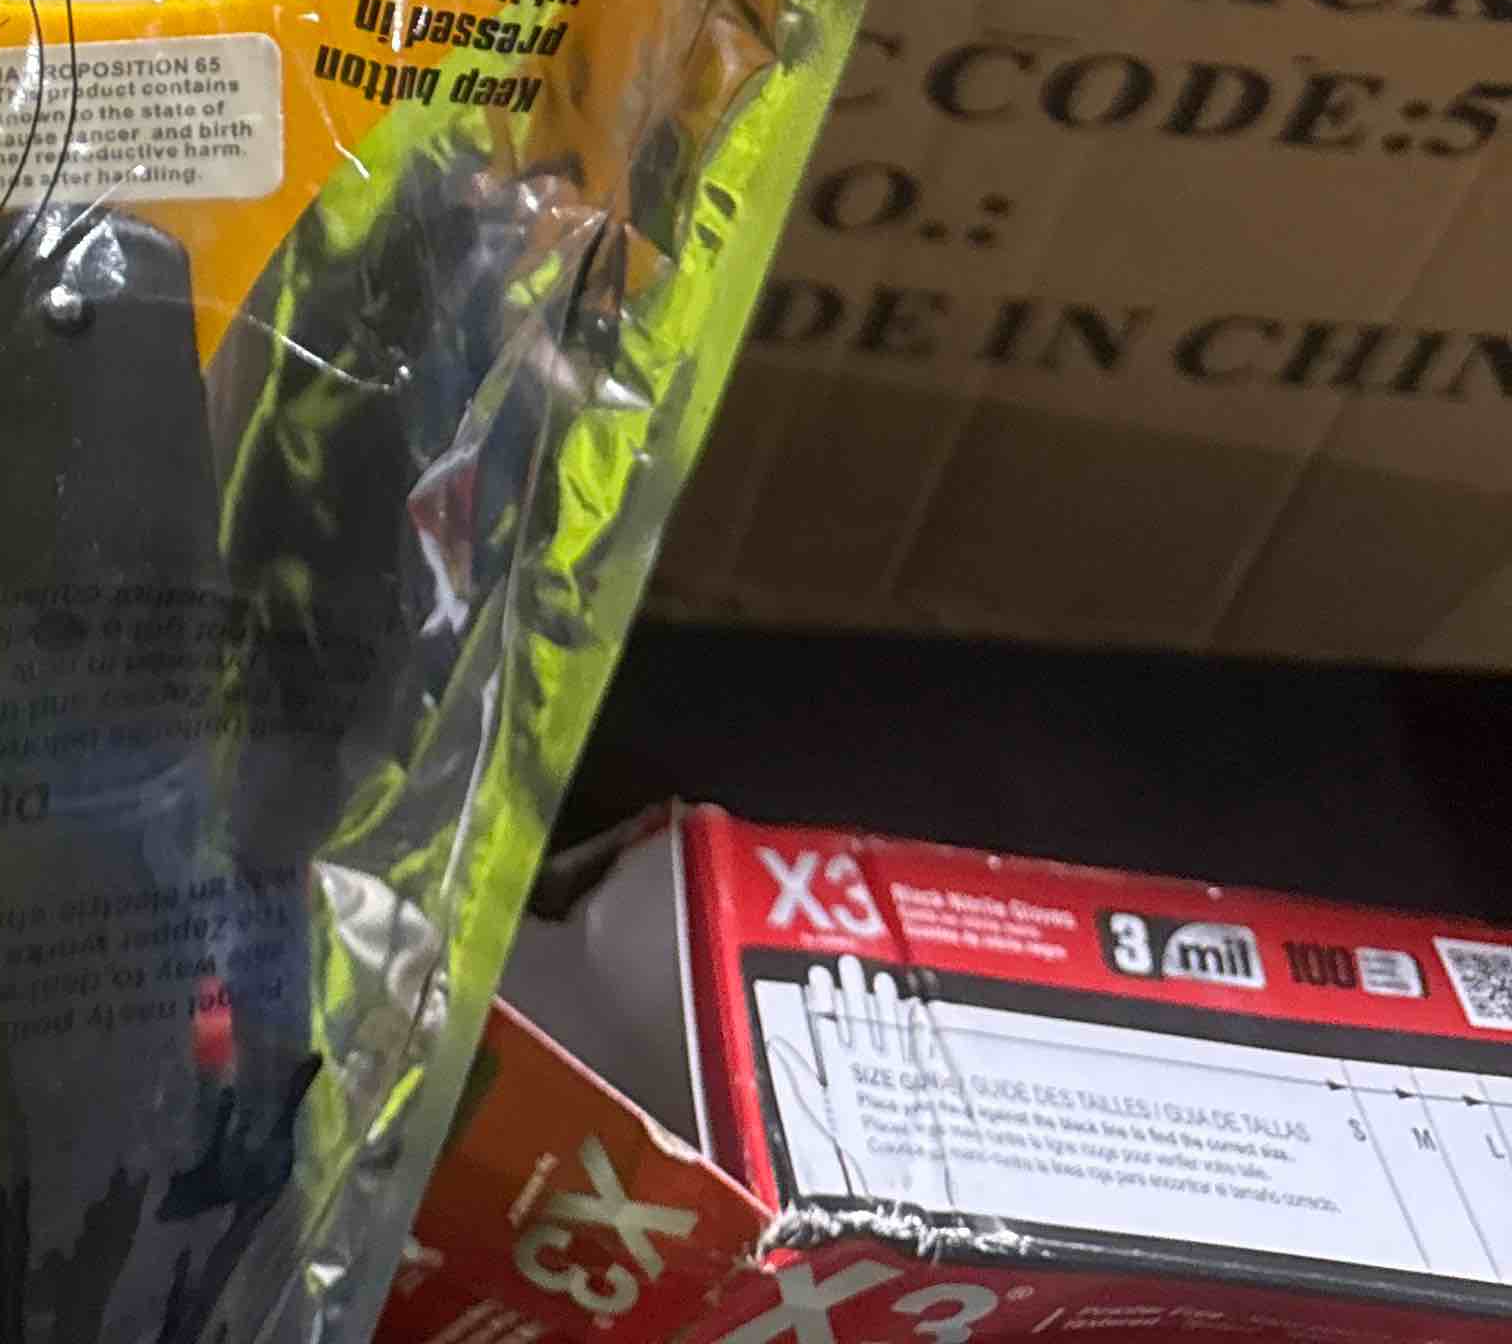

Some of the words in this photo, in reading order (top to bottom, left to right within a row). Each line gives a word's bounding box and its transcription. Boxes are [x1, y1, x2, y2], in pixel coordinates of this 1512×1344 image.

[404, 0, 568, 69] pressed
[195, 55, 221, 74] 65
[311, 44, 442, 113] button
[140, 75, 239, 97] contains
[448, 65, 542, 115] Keep
[99, 104, 134, 121] the
[140, 101, 195, 119] state
[201, 99, 224, 117] of
[151, 123, 189, 141] and
[197, 120, 252, 140] birth
[756, 845, 888, 939] X3
[1109, 911, 1154, 975] 3
[1176, 935, 1253, 979] mil
[1346, 1115, 1368, 1143] S
[1411, 1126, 1438, 1153] M
[512, 1135, 699, 1314] X3
